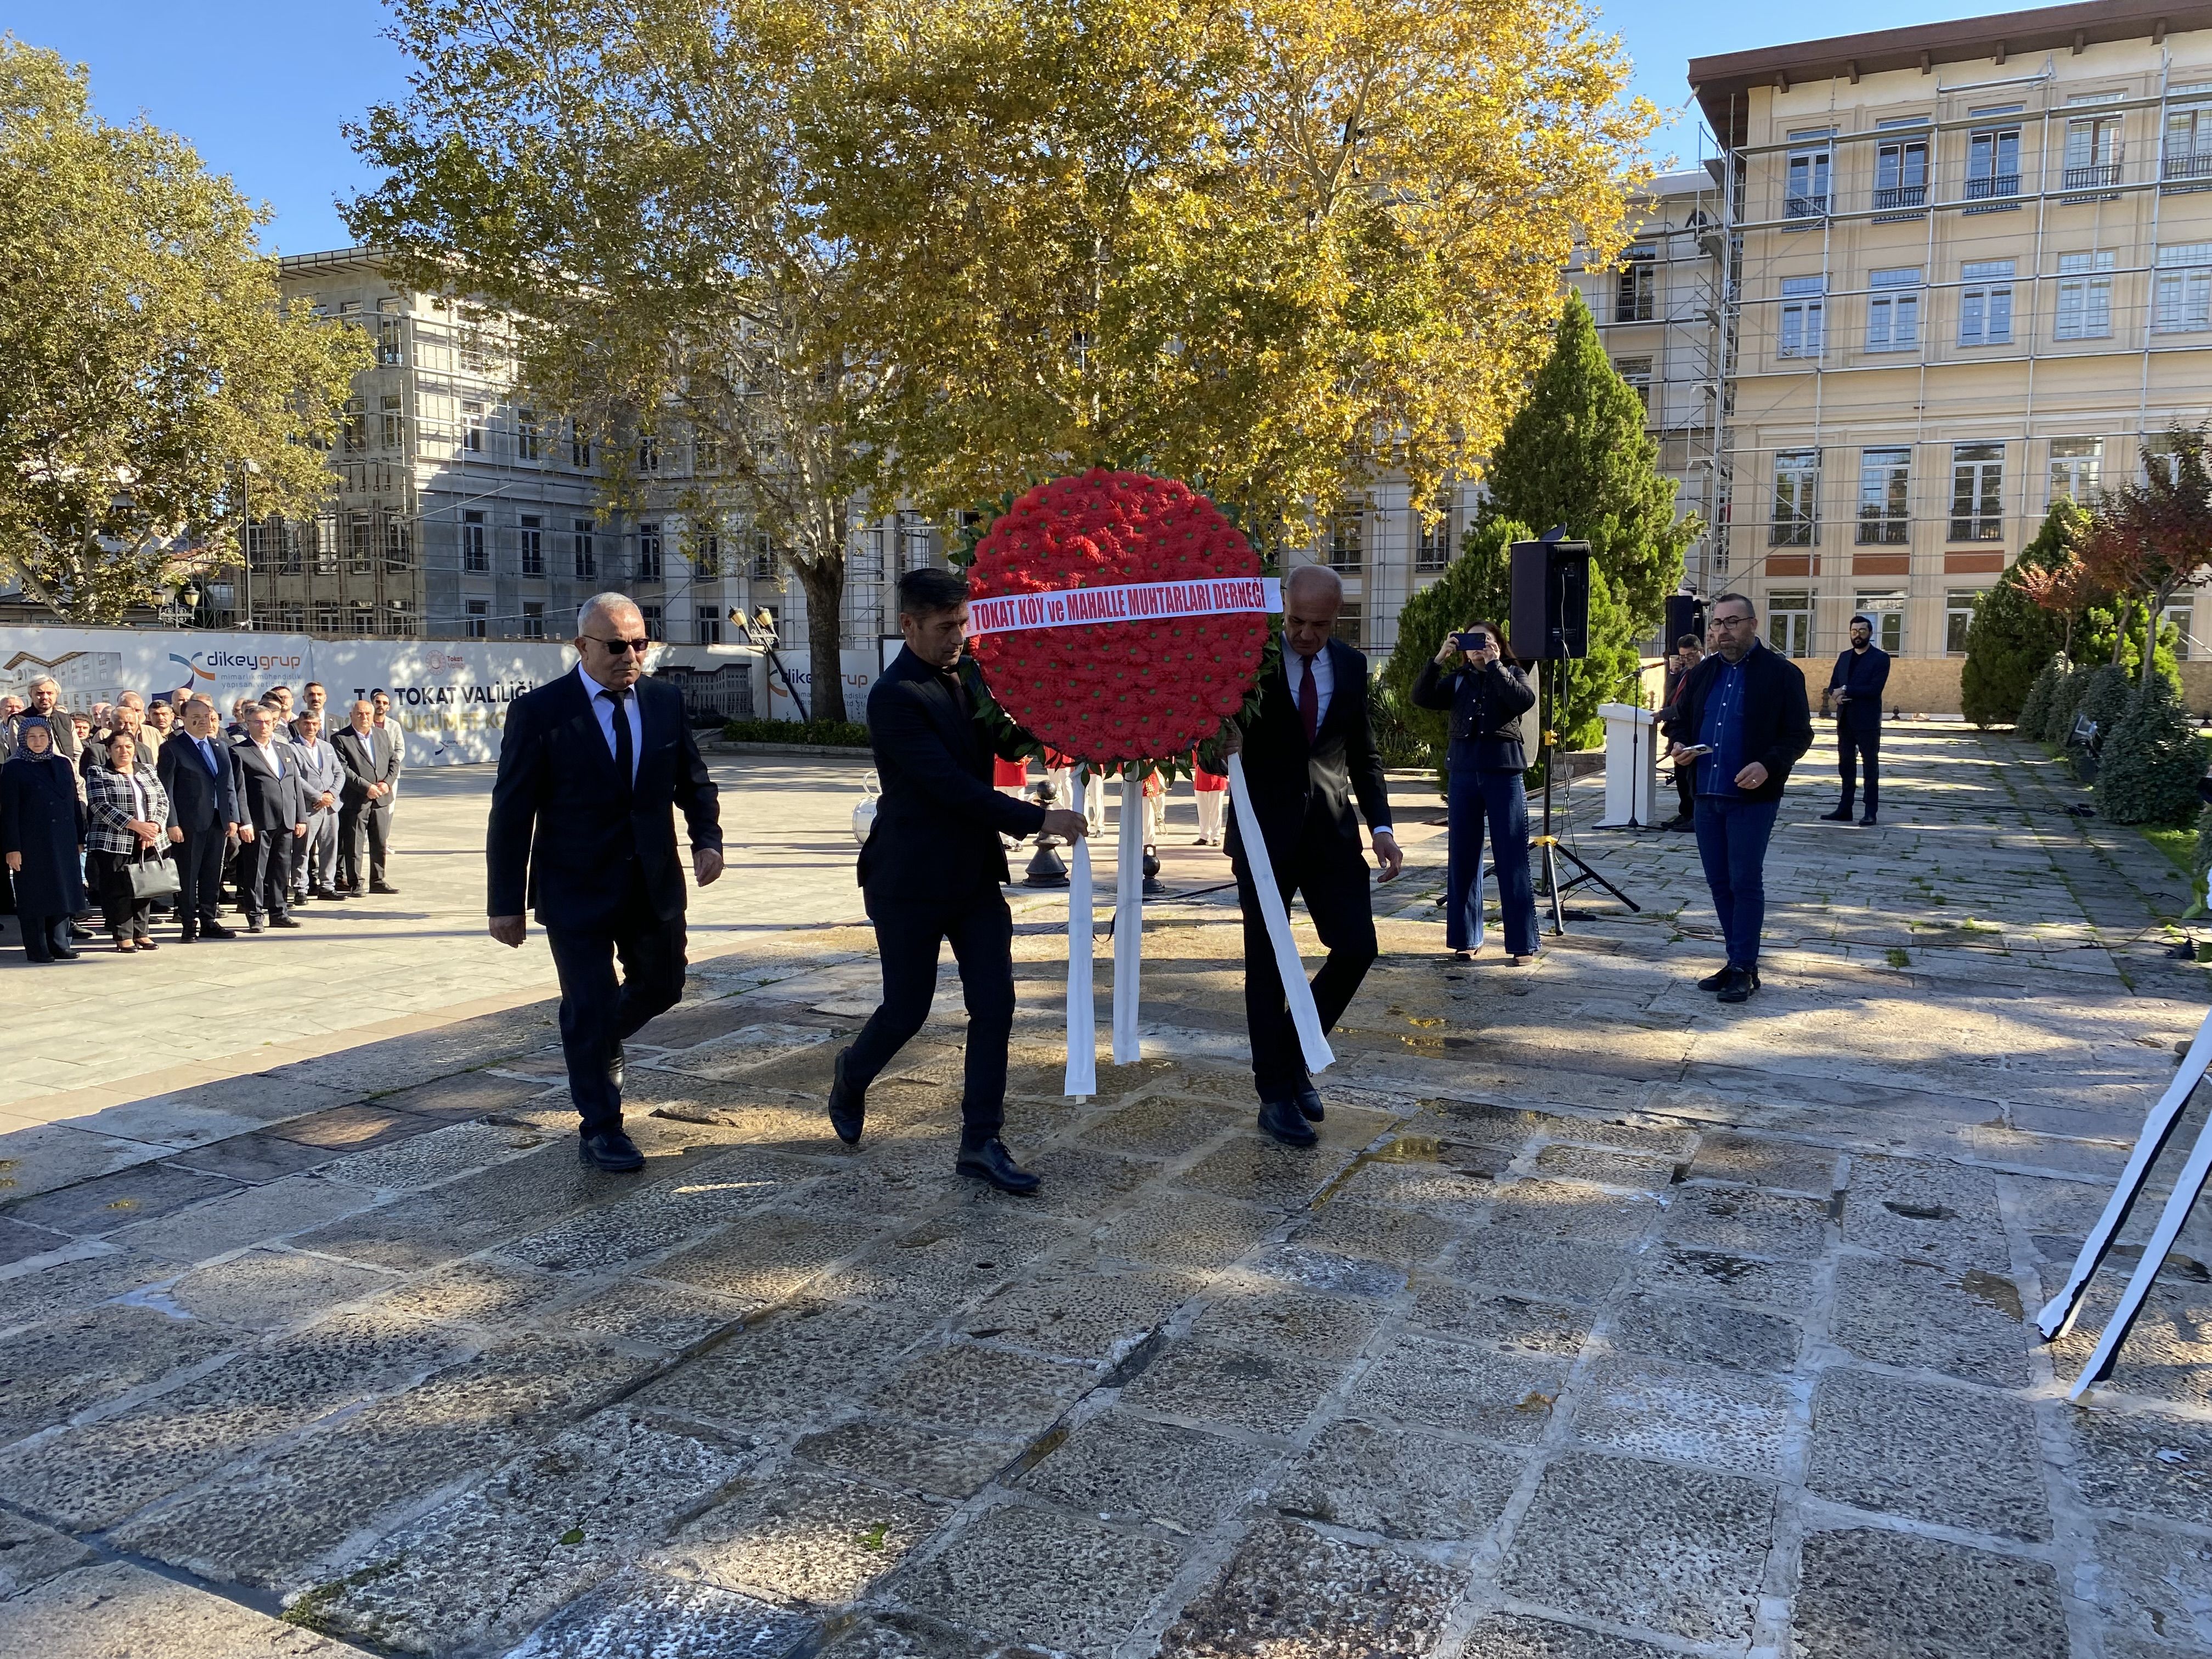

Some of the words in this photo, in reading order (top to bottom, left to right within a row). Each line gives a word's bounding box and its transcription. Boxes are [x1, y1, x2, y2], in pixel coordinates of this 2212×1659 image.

[972, 600, 1015, 630] TOKAT
[1018, 593, 1044, 625] KÖY
[1047, 600, 1064, 622] ve
[1066, 590, 1126, 620] MAHALLE
[1127, 584, 1212, 616] MUHTARLARI
[1213, 577, 1266, 610] DERNEĞİ
[207, 651, 300, 670] dikeygrup
[394, 687, 456, 706] TOKAT
